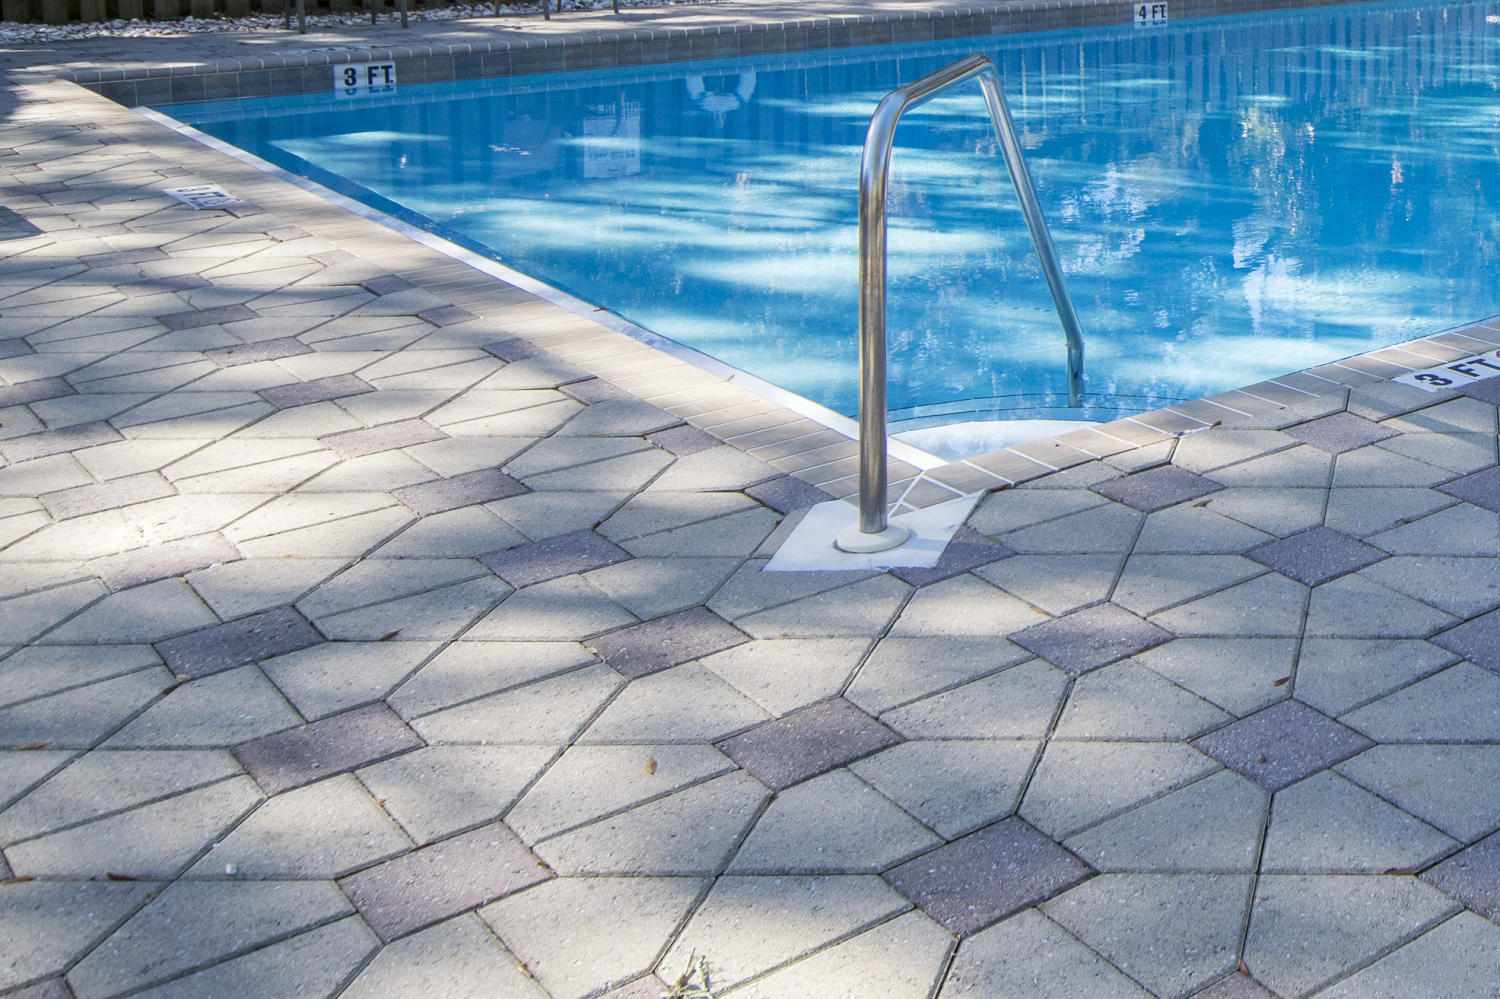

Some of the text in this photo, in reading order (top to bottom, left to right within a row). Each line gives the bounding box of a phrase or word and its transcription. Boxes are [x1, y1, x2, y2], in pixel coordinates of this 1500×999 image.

[1139, 5, 1147, 20] 4
[344, 64, 394, 86] 3 FT.
[1414, 373, 1453, 387] 3
